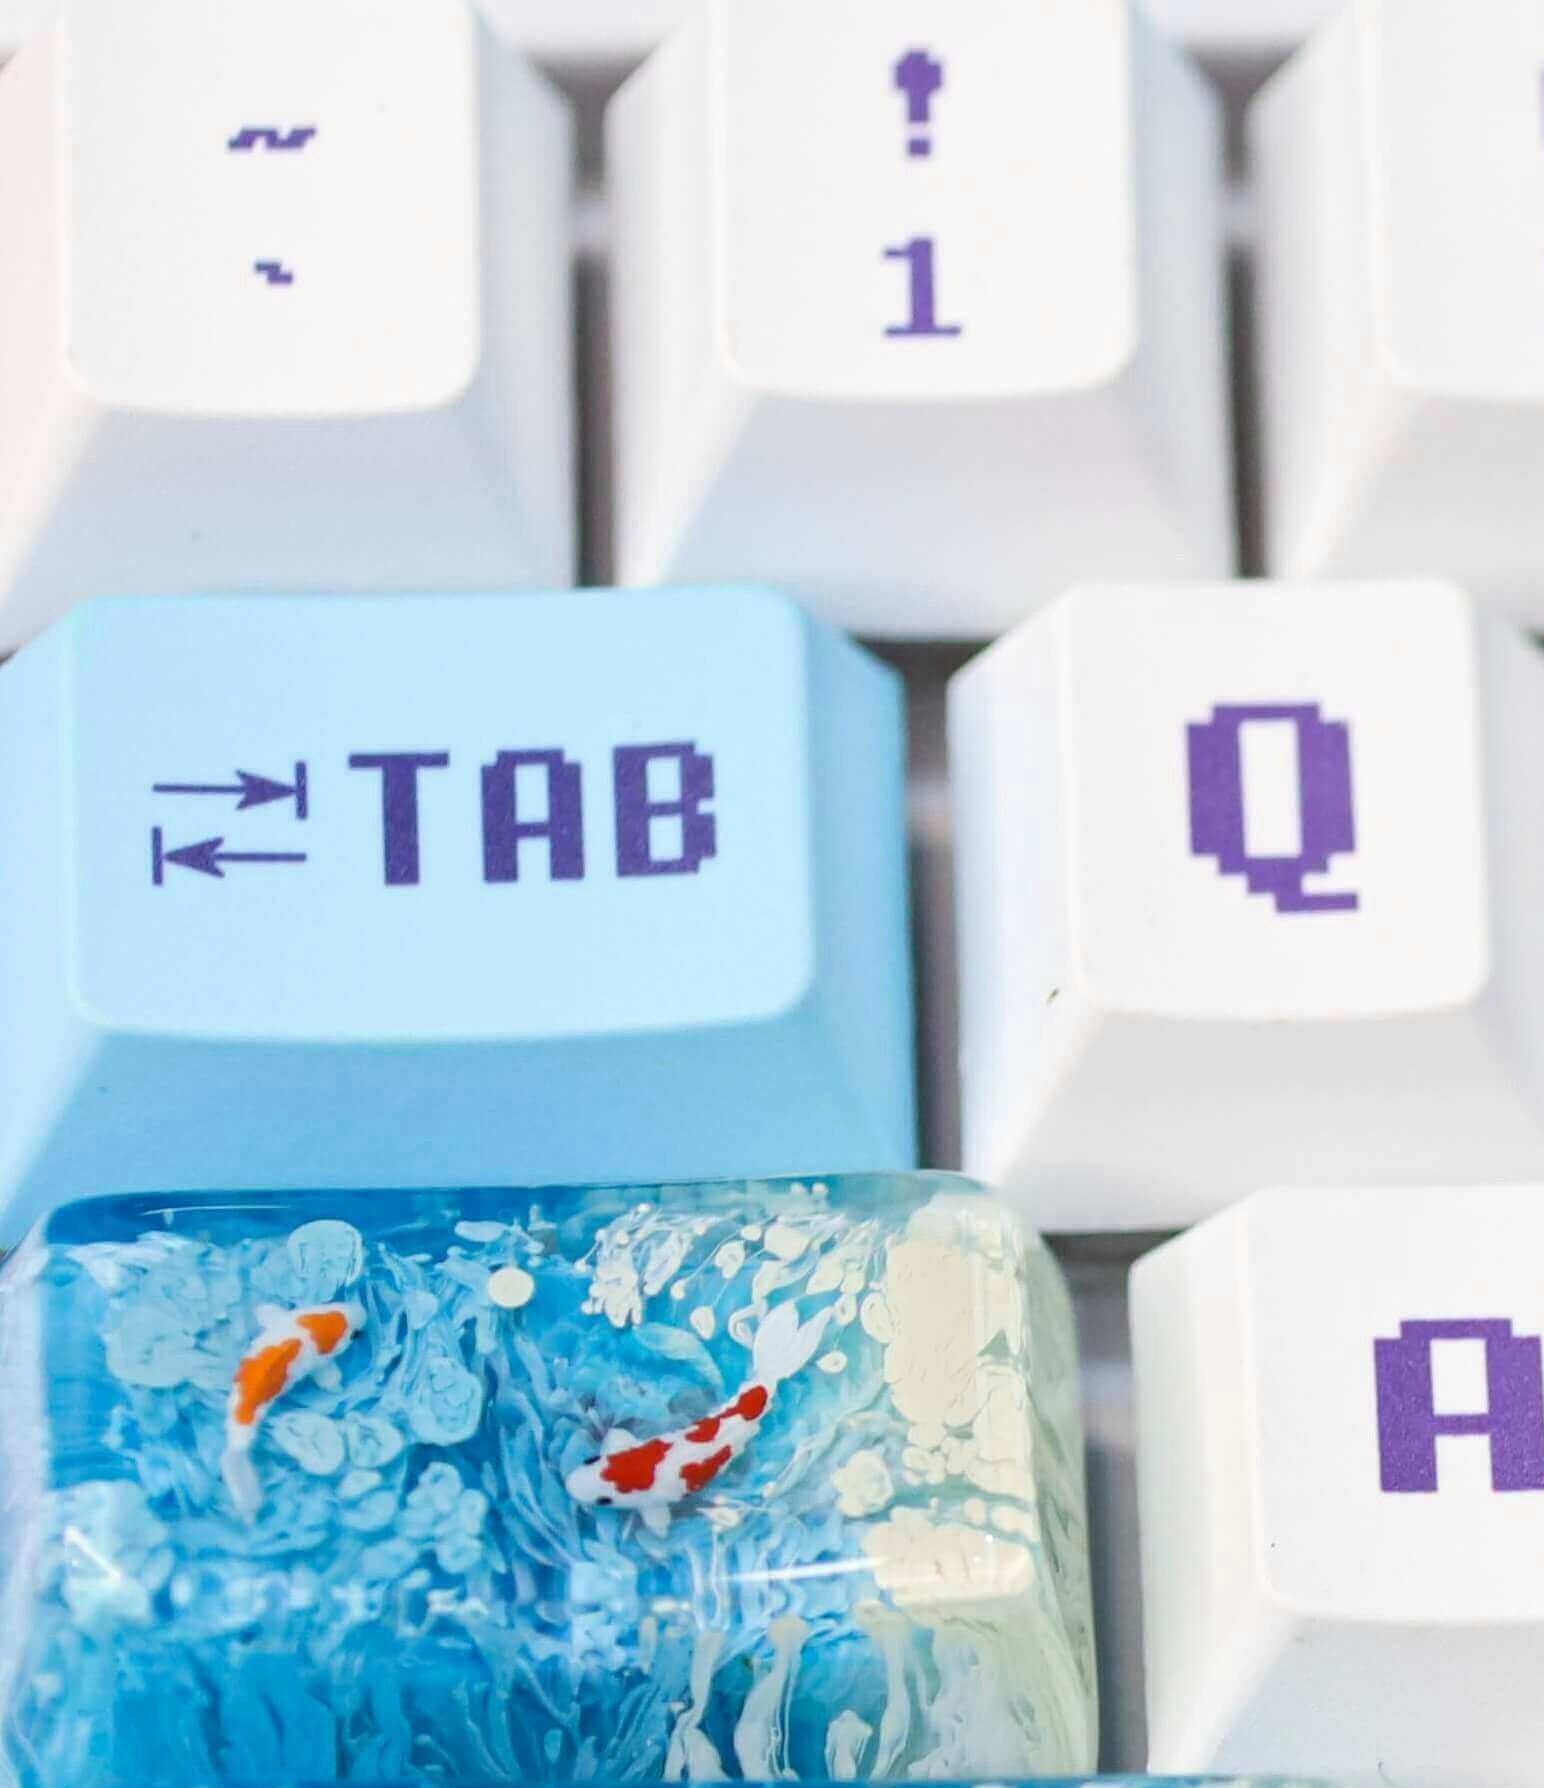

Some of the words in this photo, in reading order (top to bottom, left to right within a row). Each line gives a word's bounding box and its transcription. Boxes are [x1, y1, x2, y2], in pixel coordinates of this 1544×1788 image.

[893, 49, 944, 158] !
[884, 236, 961, 338] 1
[347, 741, 718, 887] TAB
[1187, 703, 1357, 913] Q
